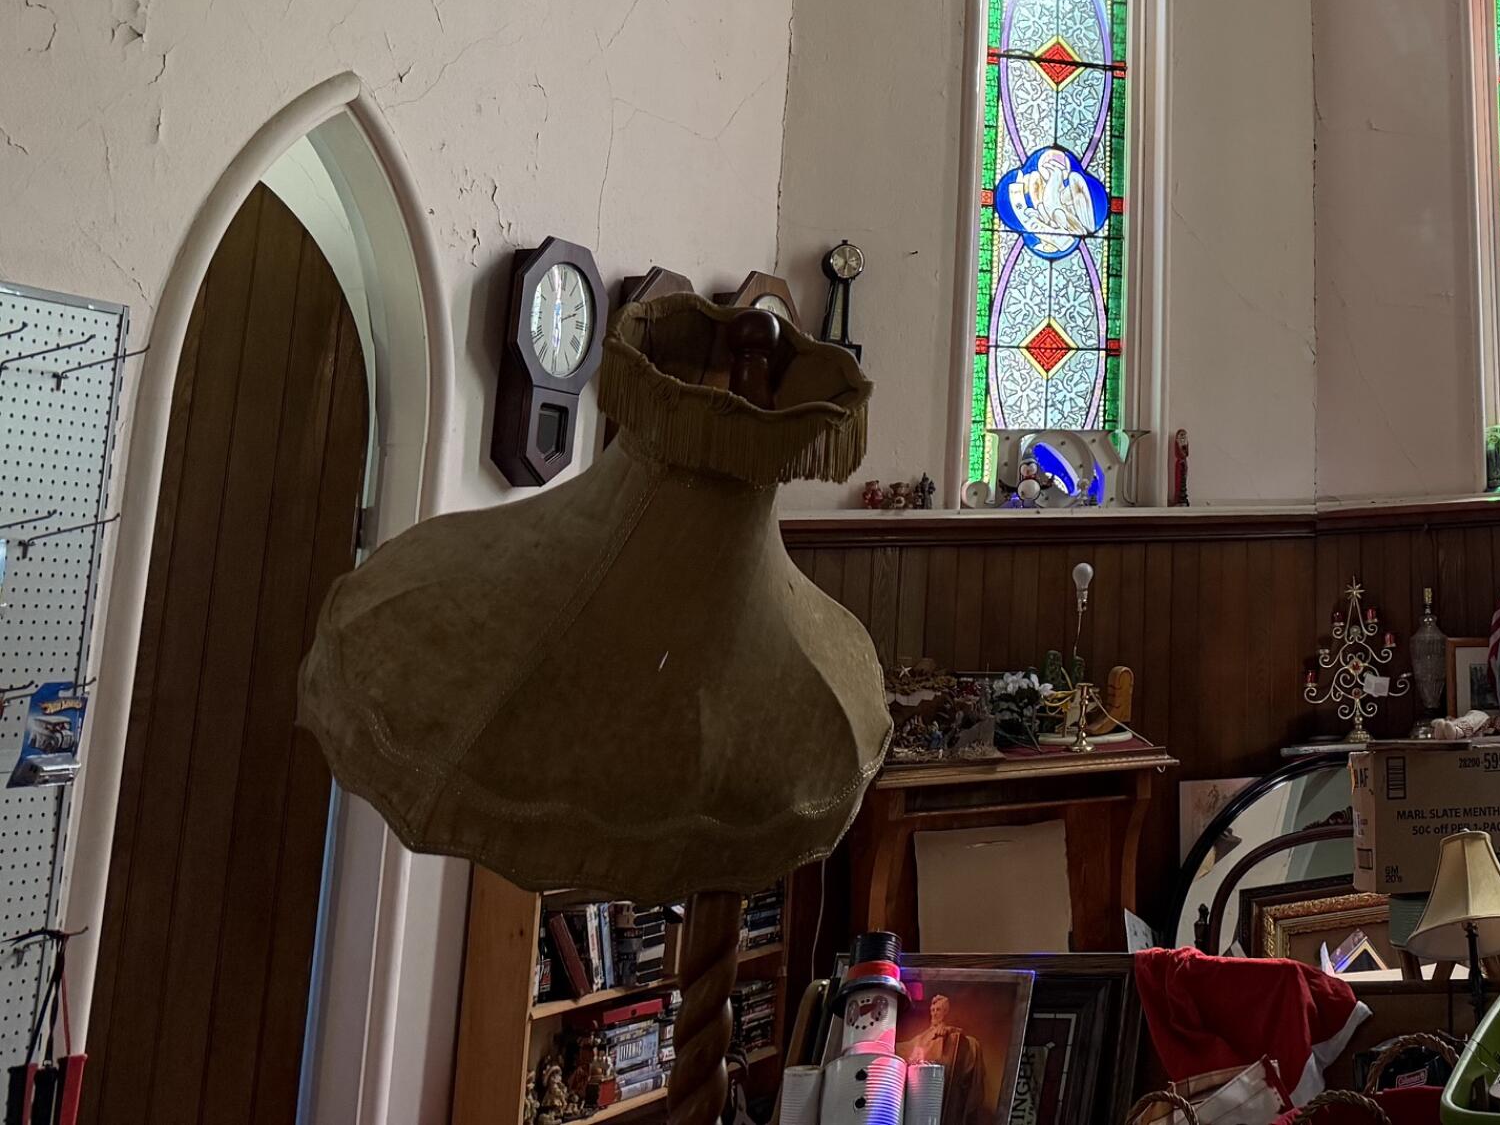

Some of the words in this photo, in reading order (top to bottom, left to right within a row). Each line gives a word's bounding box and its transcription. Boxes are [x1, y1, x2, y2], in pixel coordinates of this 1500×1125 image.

[961, 428, 1151, 509] JOY
[1396, 808, 1427, 820] MARL
[1429, 807, 1461, 819] SLATE
[1412, 824, 1431, 835] 50¢
[1433, 823, 1449, 835] off
[1451, 822, 1470, 833] PER
